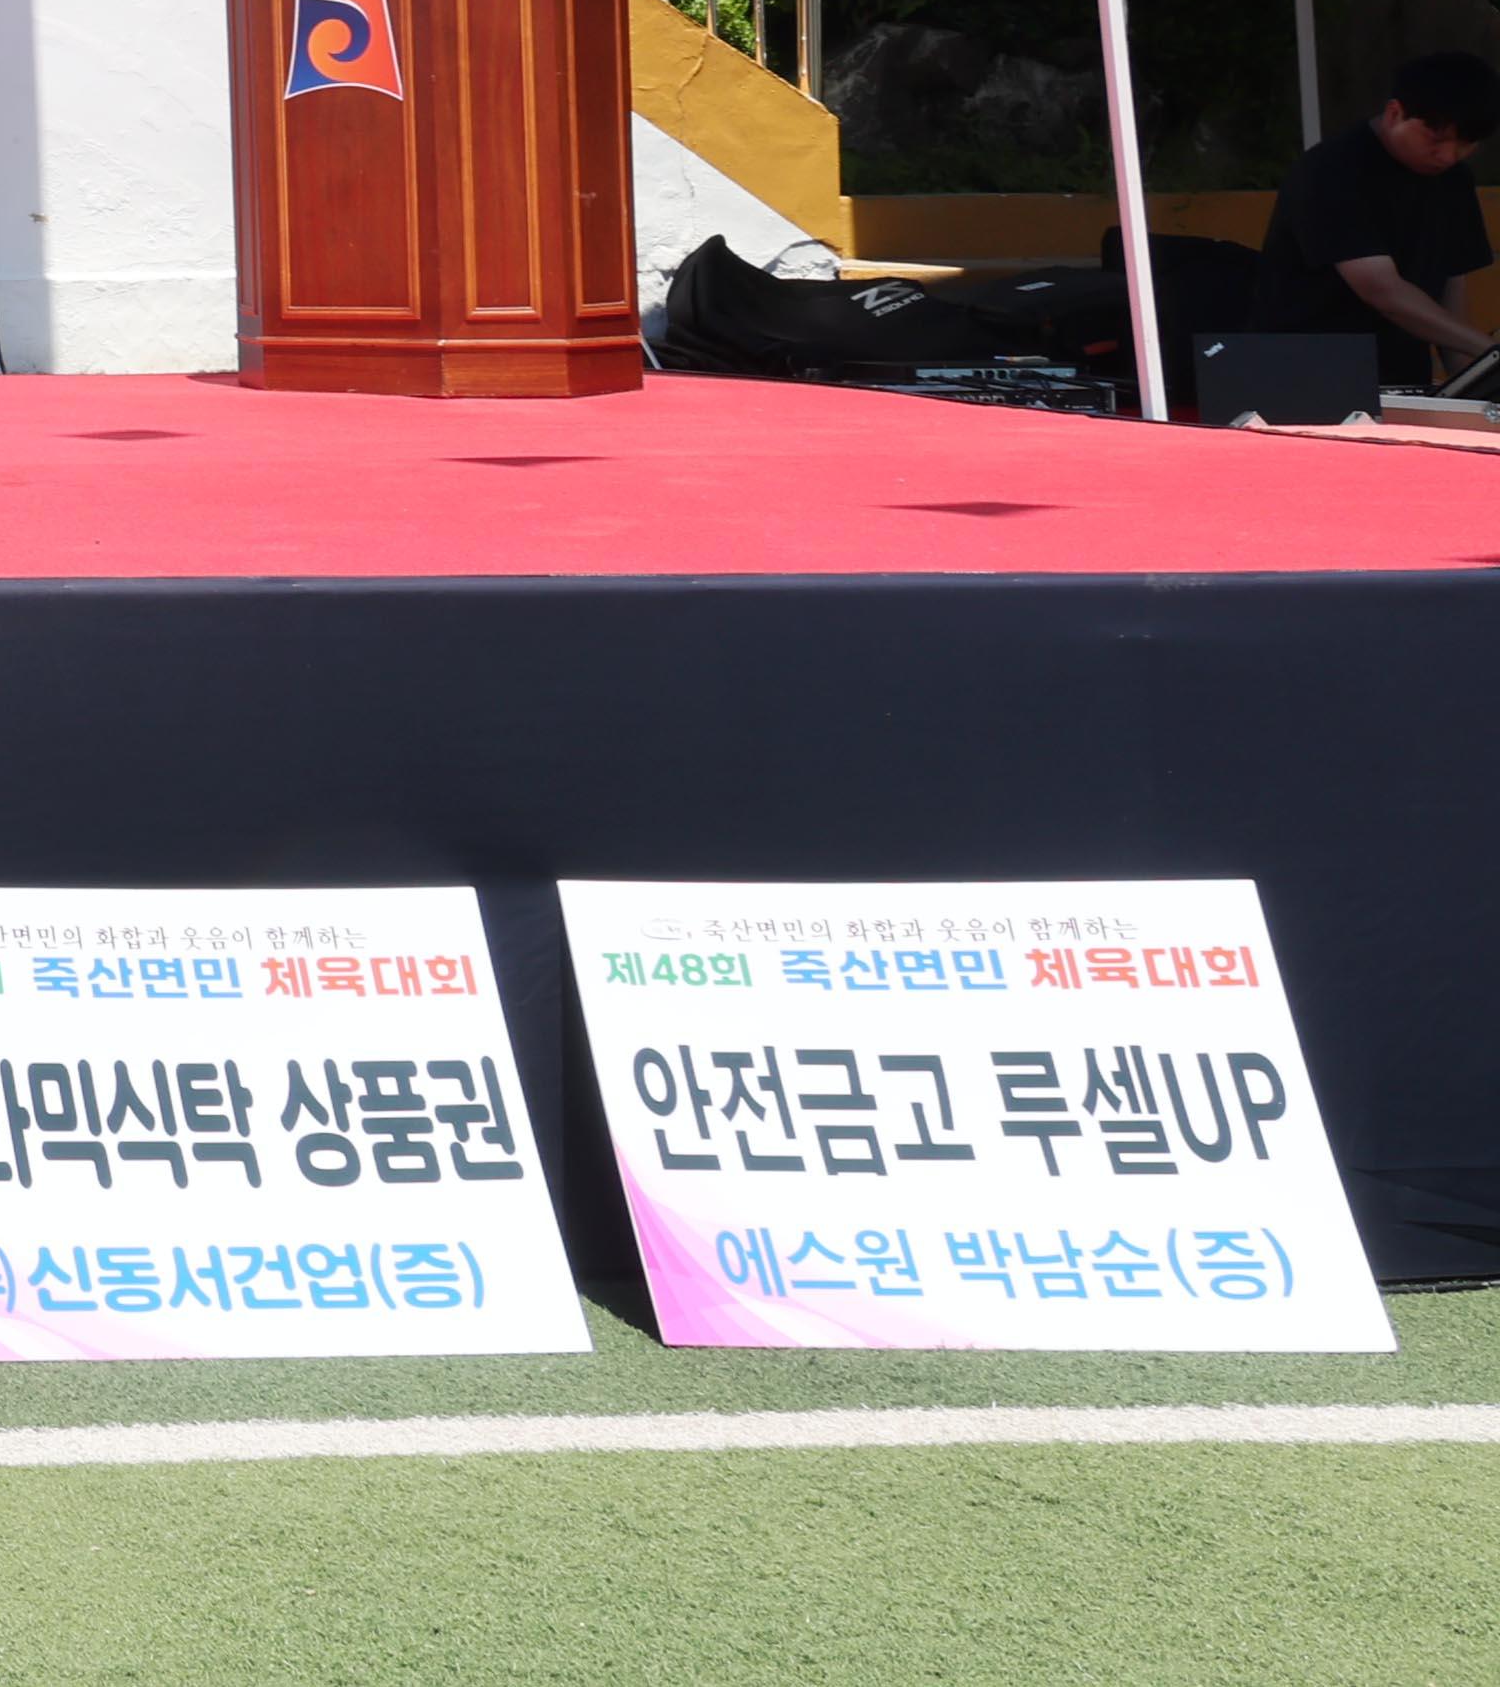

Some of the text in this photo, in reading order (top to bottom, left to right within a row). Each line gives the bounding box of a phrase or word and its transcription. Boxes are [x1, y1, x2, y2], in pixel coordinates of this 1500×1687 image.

[96, 924, 169, 950] 화합과
[179, 925, 252, 951] 웃음이
[264, 926, 369, 951] 함께하는
[702, 916, 1140, 944] 죽산면민의 화합과 웃음이 함께하는
[30, 954, 245, 1000] 죽산면민
[259, 953, 479, 998] 체육대회
[602, 944, 1261, 992] 제48회 죽산면민 체육대회
[279, 1054, 526, 1188] 상품권
[632, 1044, 1288, 1176] 안전금고 루셀UP
[713, 1226, 1296, 1301] 에스원 박남순(증)
